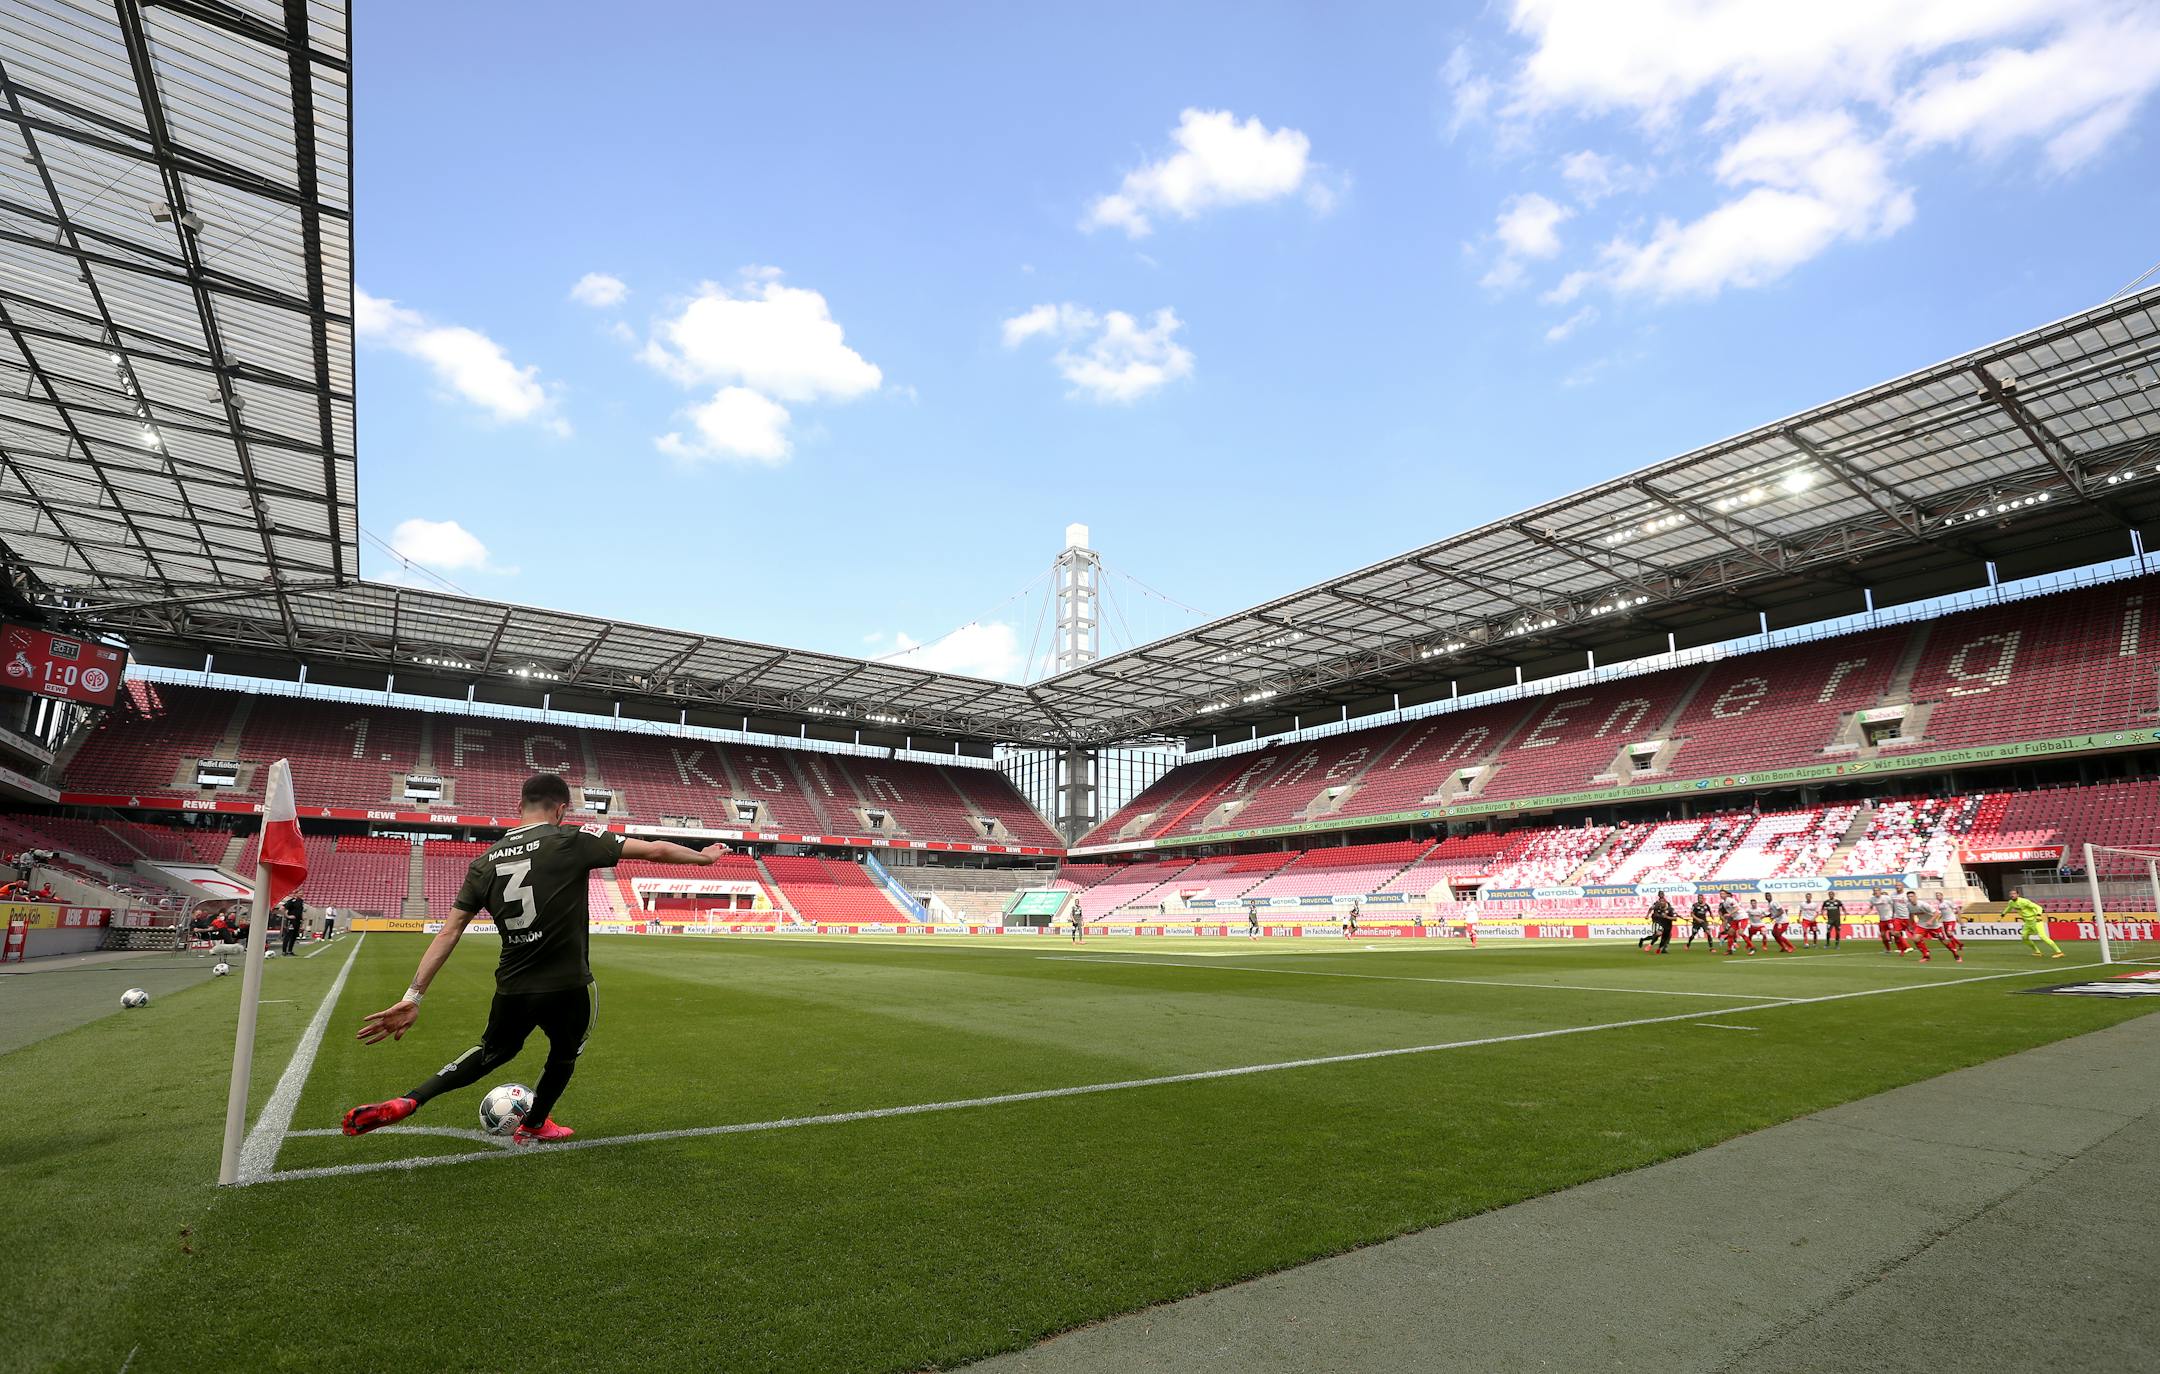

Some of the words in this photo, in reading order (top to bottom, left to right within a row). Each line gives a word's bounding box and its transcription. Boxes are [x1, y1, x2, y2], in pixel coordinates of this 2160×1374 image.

[44, 661, 78, 686] 1:0
[46, 686, 66, 694] REWE
[1874, 760, 1892, 769] Wir
[1895, 756, 1936, 767] fliegen
[1940, 752, 1972, 762] nicht
[1976, 750, 1995, 758] nur
[2000, 746, 2020, 756] auf
[2025, 740, 2079, 752] Fußball.
[1772, 772, 1794, 780] Bonn
[1796, 768, 1832, 777] Airport
[1572, 793, 1592, 801] nicht
[182, 800, 216, 810] REWE
[1486, 802, 1508, 812] Airport
[367, 811, 396, 820] REWE
[430, 814, 458, 823] REWE
[758, 832, 780, 840] REWE
[802, 835, 821, 843] REWE
[489, 846, 524, 861] MAINZ
[526, 840, 540, 852] 05
[1980, 852, 2026, 862] SPÜRBAR
[2028, 850, 2060, 860] ANDERS.
[1641, 884, 1690, 894] MOTORÖL
[1699, 882, 1756, 891] RAVENOL
[1764, 878, 1822, 890] MOTORÖL
[496, 858, 537, 930] 3
[1537, 888, 1580, 897] MOTORÖL
[1586, 887, 1634, 896] RAVENOL
[65, 908, 83, 926] REWE
[1476, 928, 1520, 936] ennerfleisch
[1538, 926, 1574, 938] RINTI
[1602, 928, 1652, 936] Fachhande
[2078, 923, 2154, 940] RNTI
